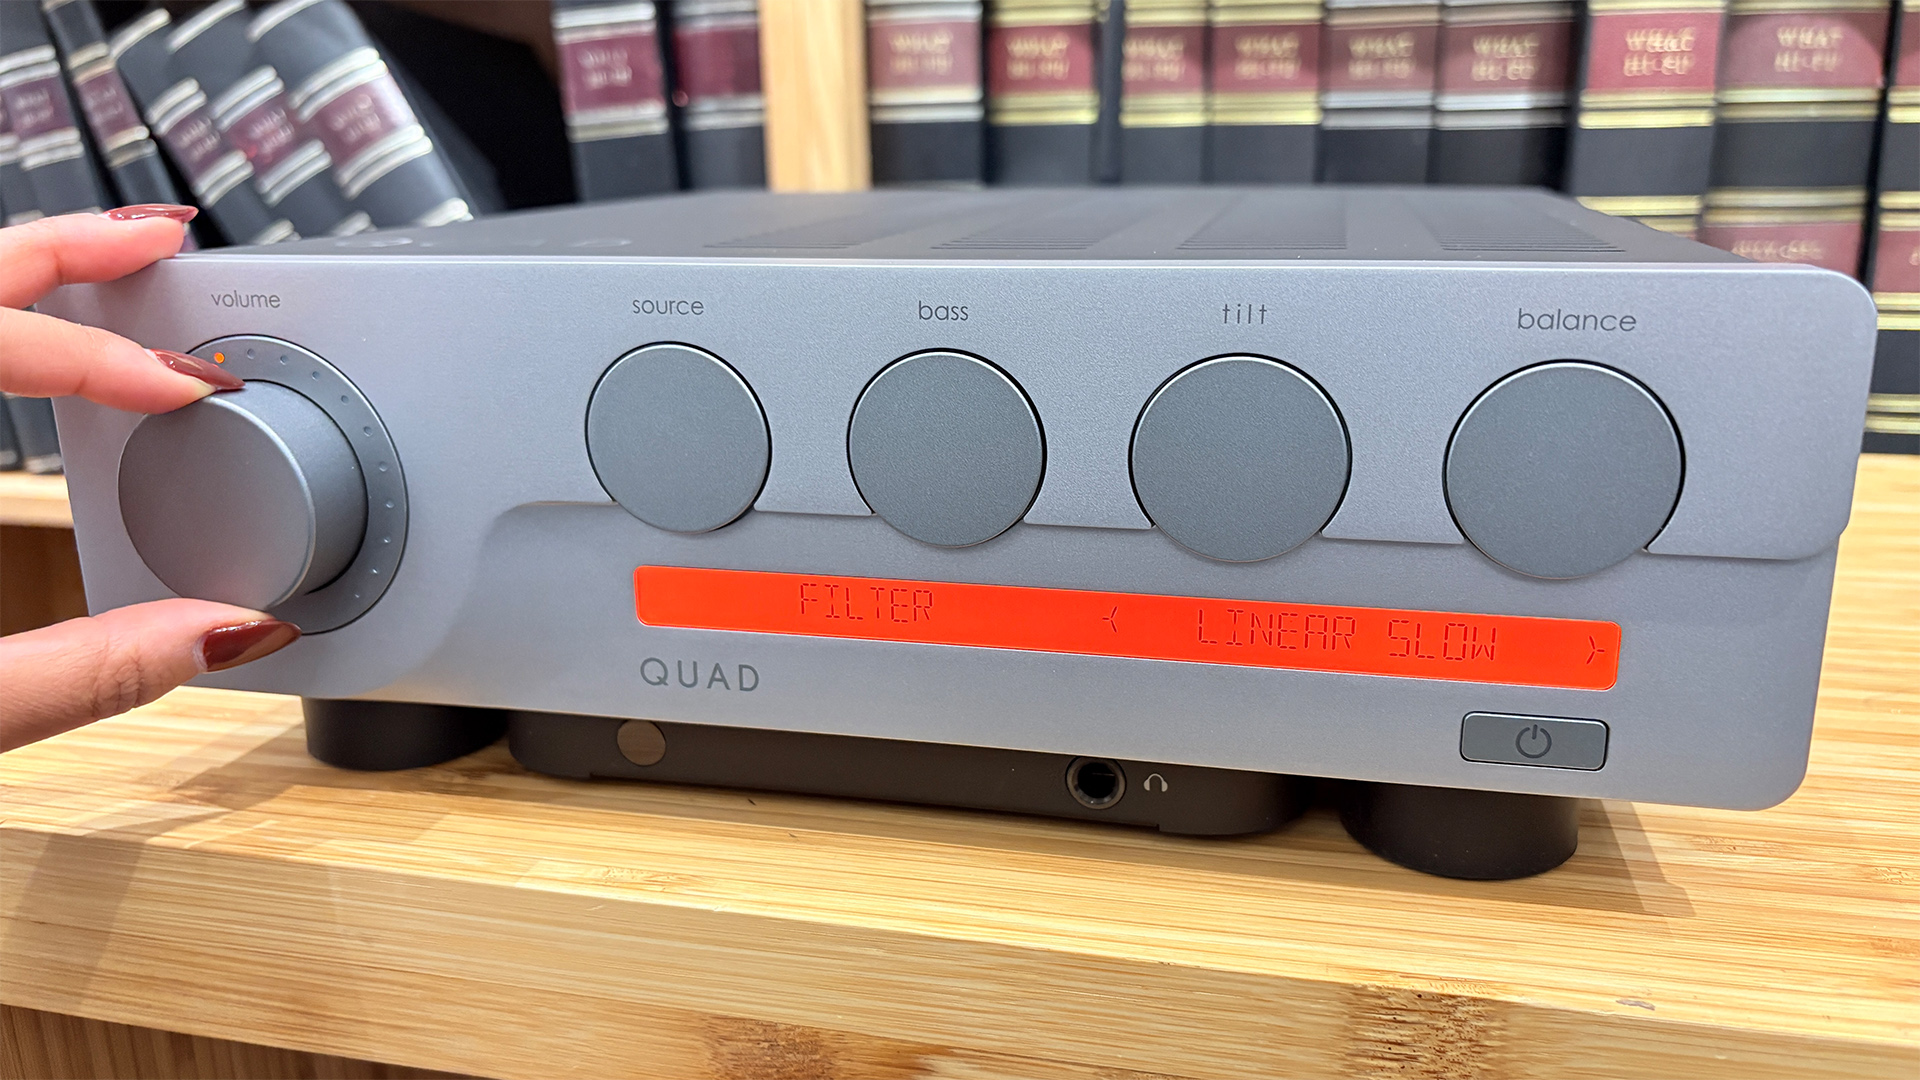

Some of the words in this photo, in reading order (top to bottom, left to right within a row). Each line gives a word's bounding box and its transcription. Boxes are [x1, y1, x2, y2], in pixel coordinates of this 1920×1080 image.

[210, 289, 281, 309] volume
[632, 299, 705, 316] source
[917, 300, 969, 322] bass
[1222, 303, 1268, 325] tilt
[1517, 307, 1637, 332] balance
[798, 581, 935, 625] FILTER
[1196, 607, 1357, 651] LINEAR
[1387, 618, 1498, 662] SLOW
[639, 656, 761, 692] QUAD
